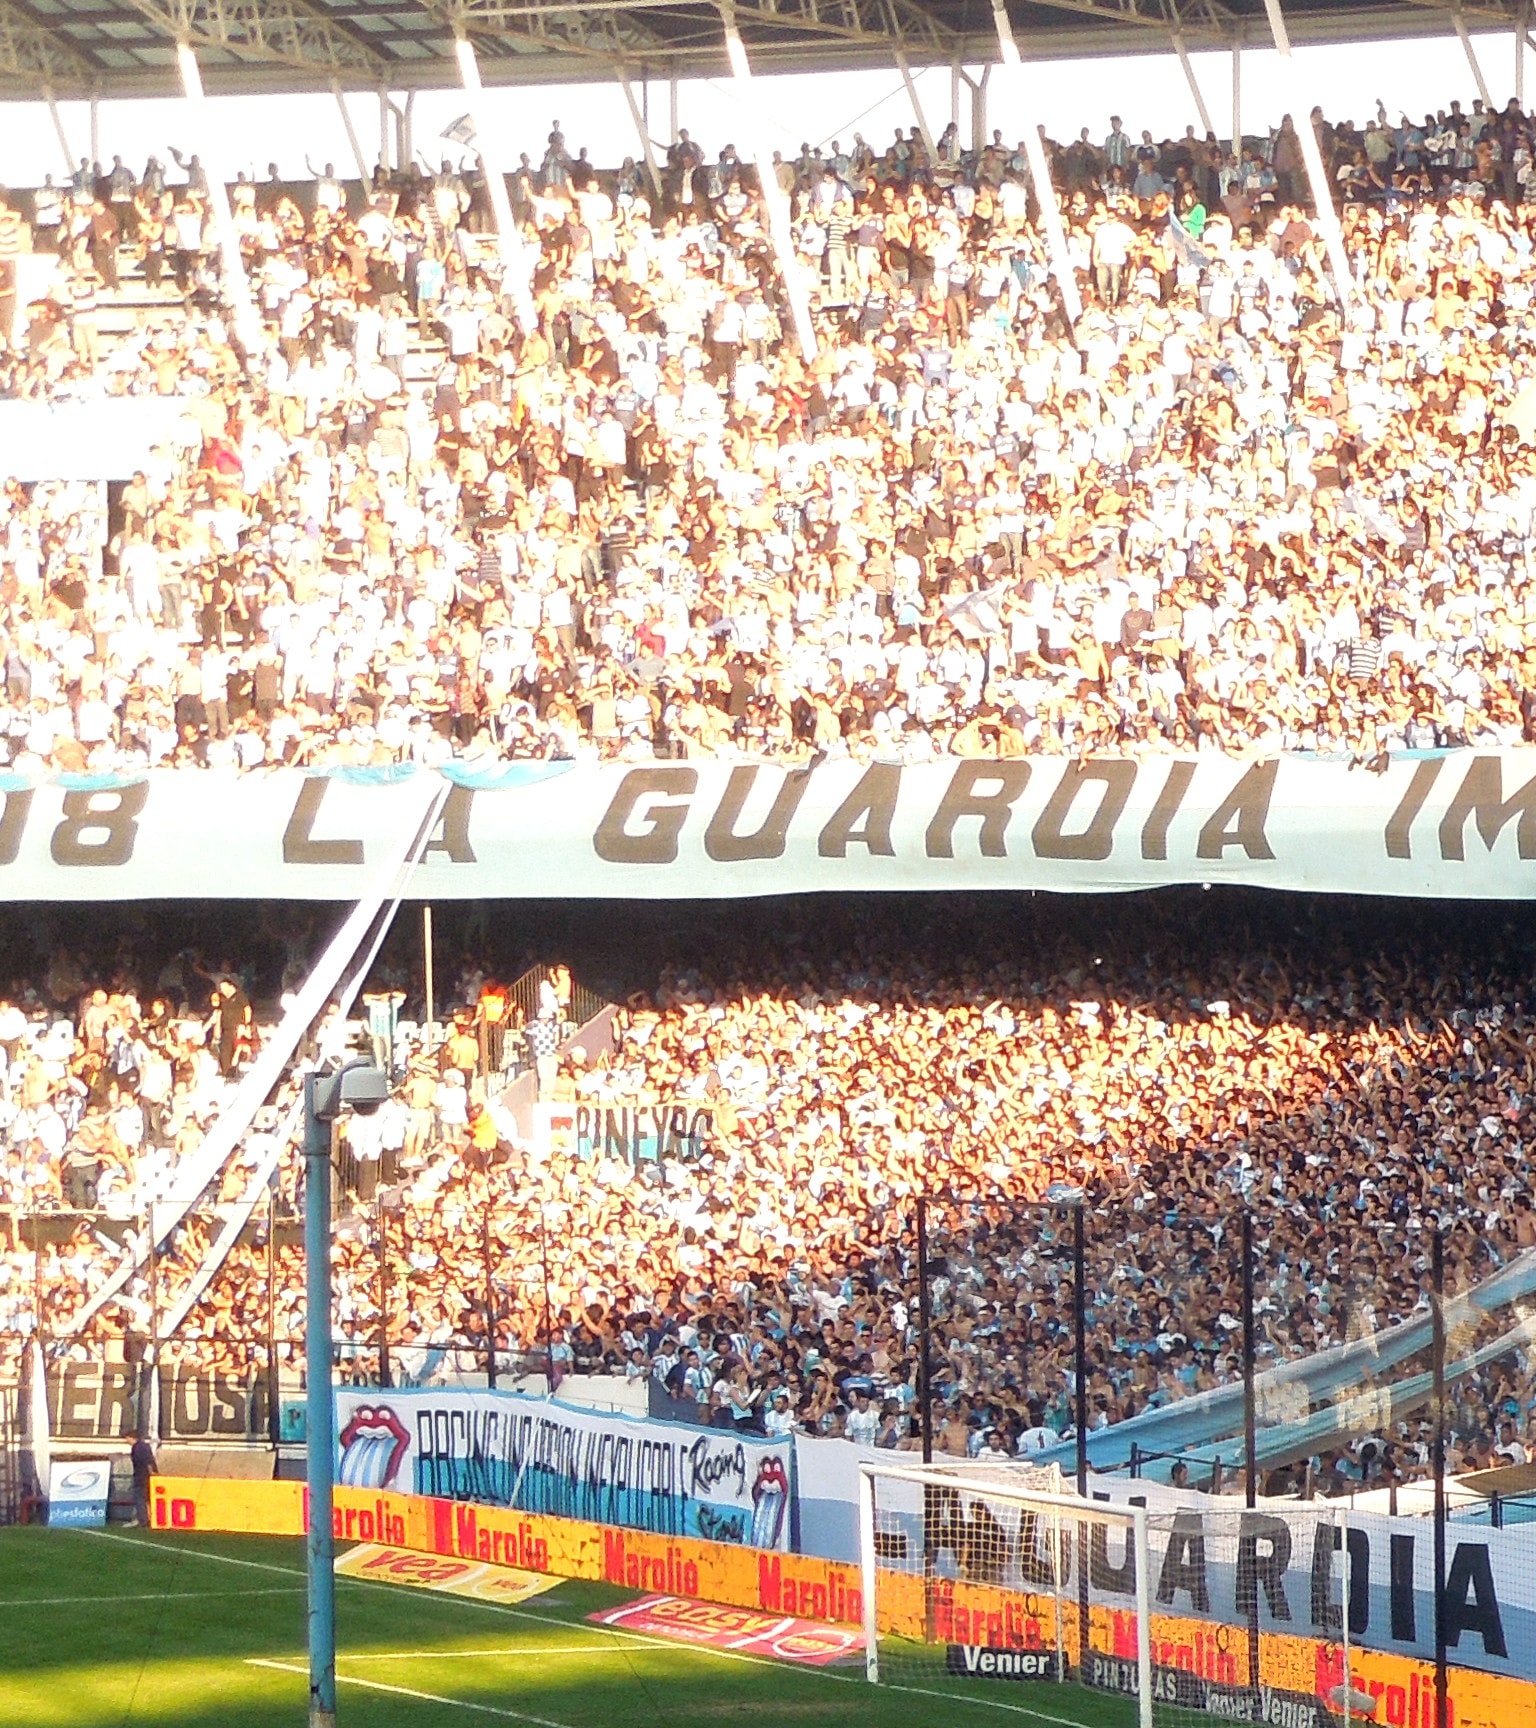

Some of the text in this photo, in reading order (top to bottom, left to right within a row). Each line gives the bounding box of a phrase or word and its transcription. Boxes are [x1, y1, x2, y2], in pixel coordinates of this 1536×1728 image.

[283, 775, 477, 863] LA
[593, 756, 1276, 863] GUARDIA
[332, 1499, 405, 1546] arolio
[456, 1504, 548, 1571] Marolio
[362, 1550, 470, 1580] vea
[604, 1530, 698, 1595] Marolio
[758, 1553, 864, 1623] Marolio
[649, 1600, 780, 1636] easy
[963, 1644, 1049, 1675] Venier
[1094, 1658, 1177, 1700] PINTUAS
